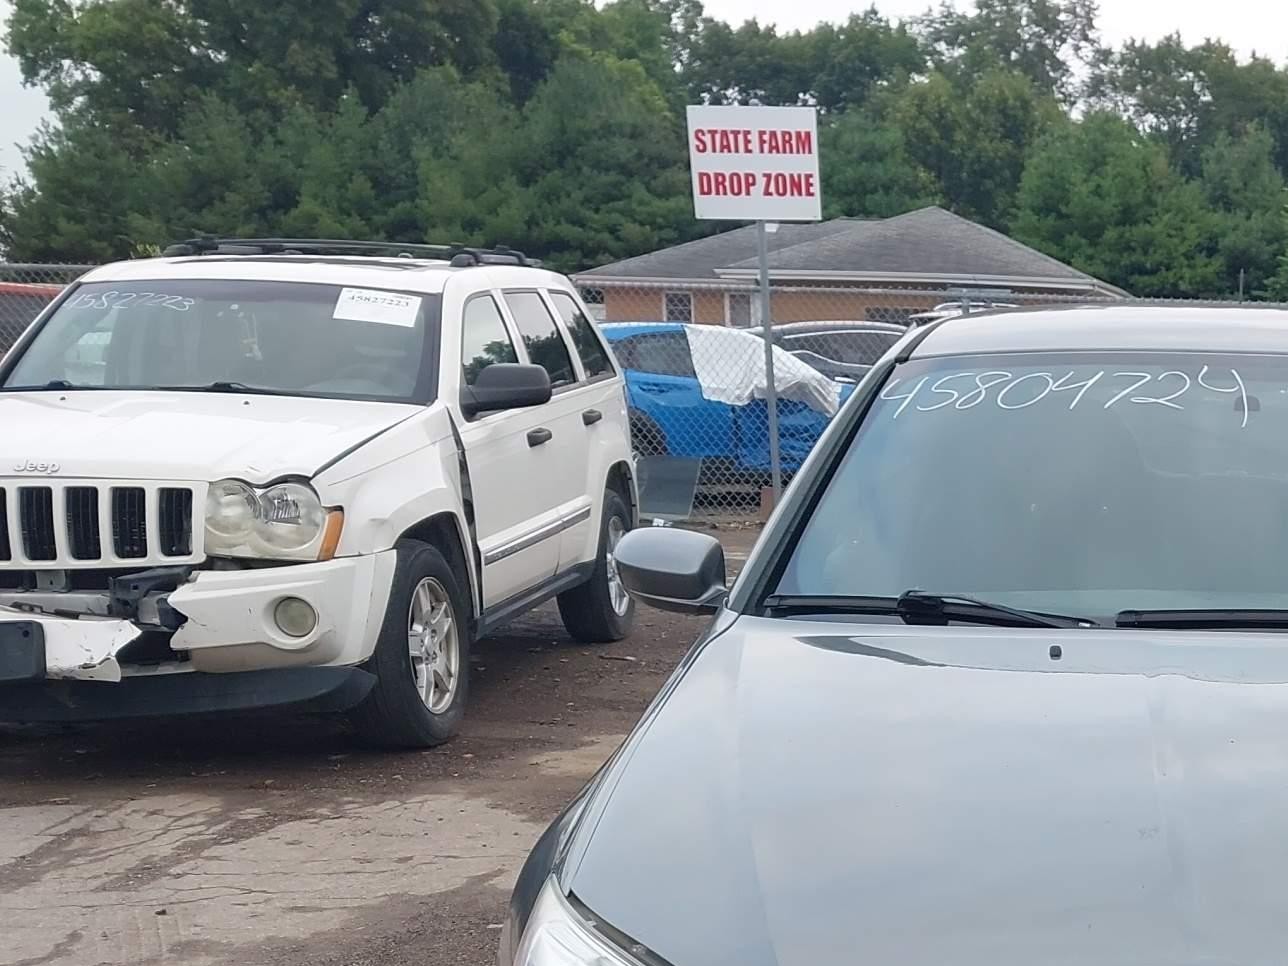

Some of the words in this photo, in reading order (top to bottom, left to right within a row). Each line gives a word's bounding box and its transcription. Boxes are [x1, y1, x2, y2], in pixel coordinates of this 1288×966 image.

[694, 129, 753, 153] STATE
[758, 130, 813, 154] FARM
[698, 172, 757, 196] DROP
[762, 173, 815, 197] ZONE
[880, 364, 1250, 428] 45804724
[13, 456, 62, 475] Jeep
